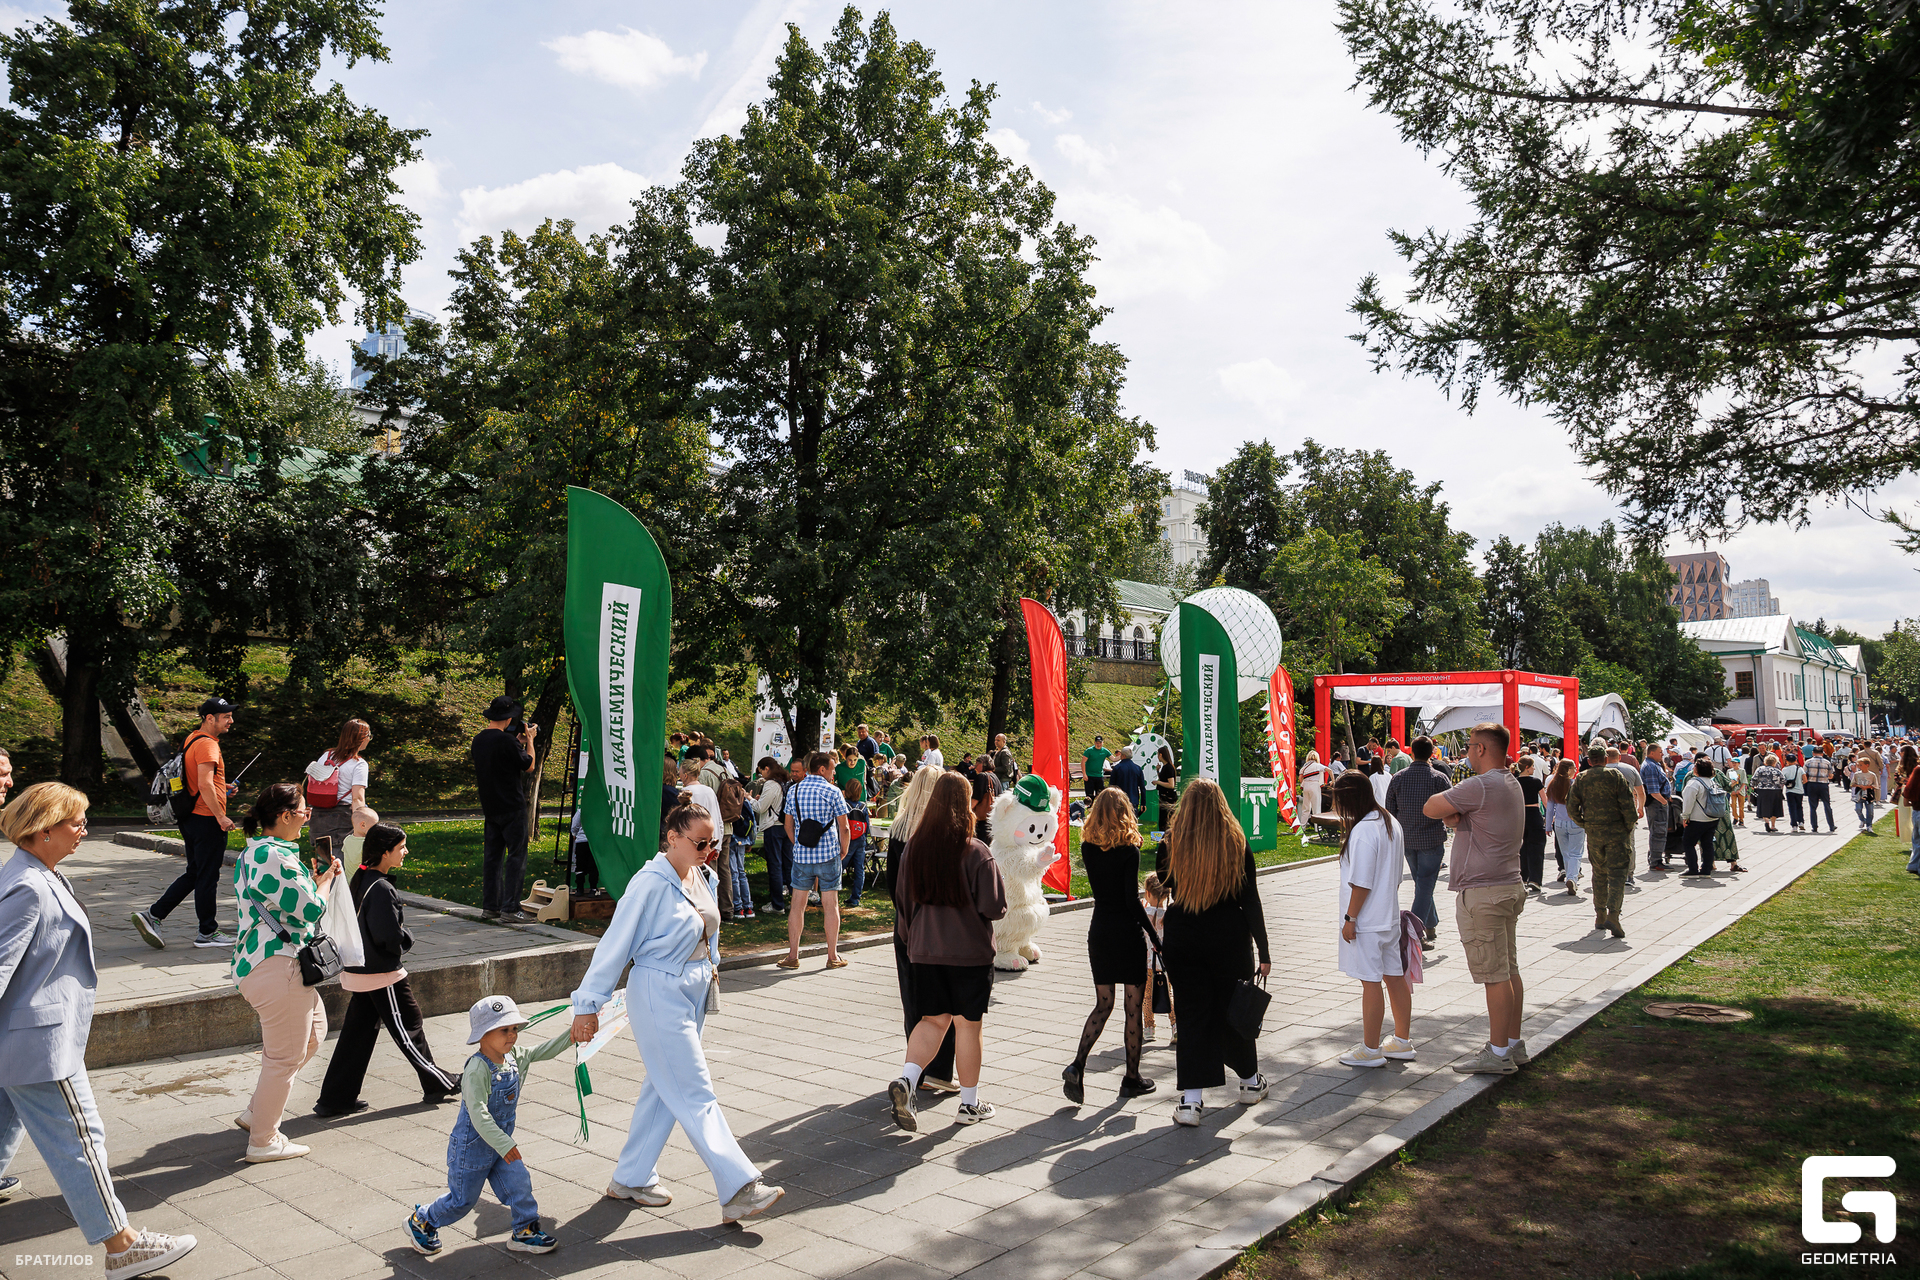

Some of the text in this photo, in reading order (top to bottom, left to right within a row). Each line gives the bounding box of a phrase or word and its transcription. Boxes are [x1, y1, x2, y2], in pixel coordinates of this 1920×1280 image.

[608, 600, 629, 780] АКАДЕМИЧЕСКИЙ
[1201, 664, 1214, 773] АКАДЕМИЧЕСКИЙ
[1405, 675, 1451, 683] девелопмент
